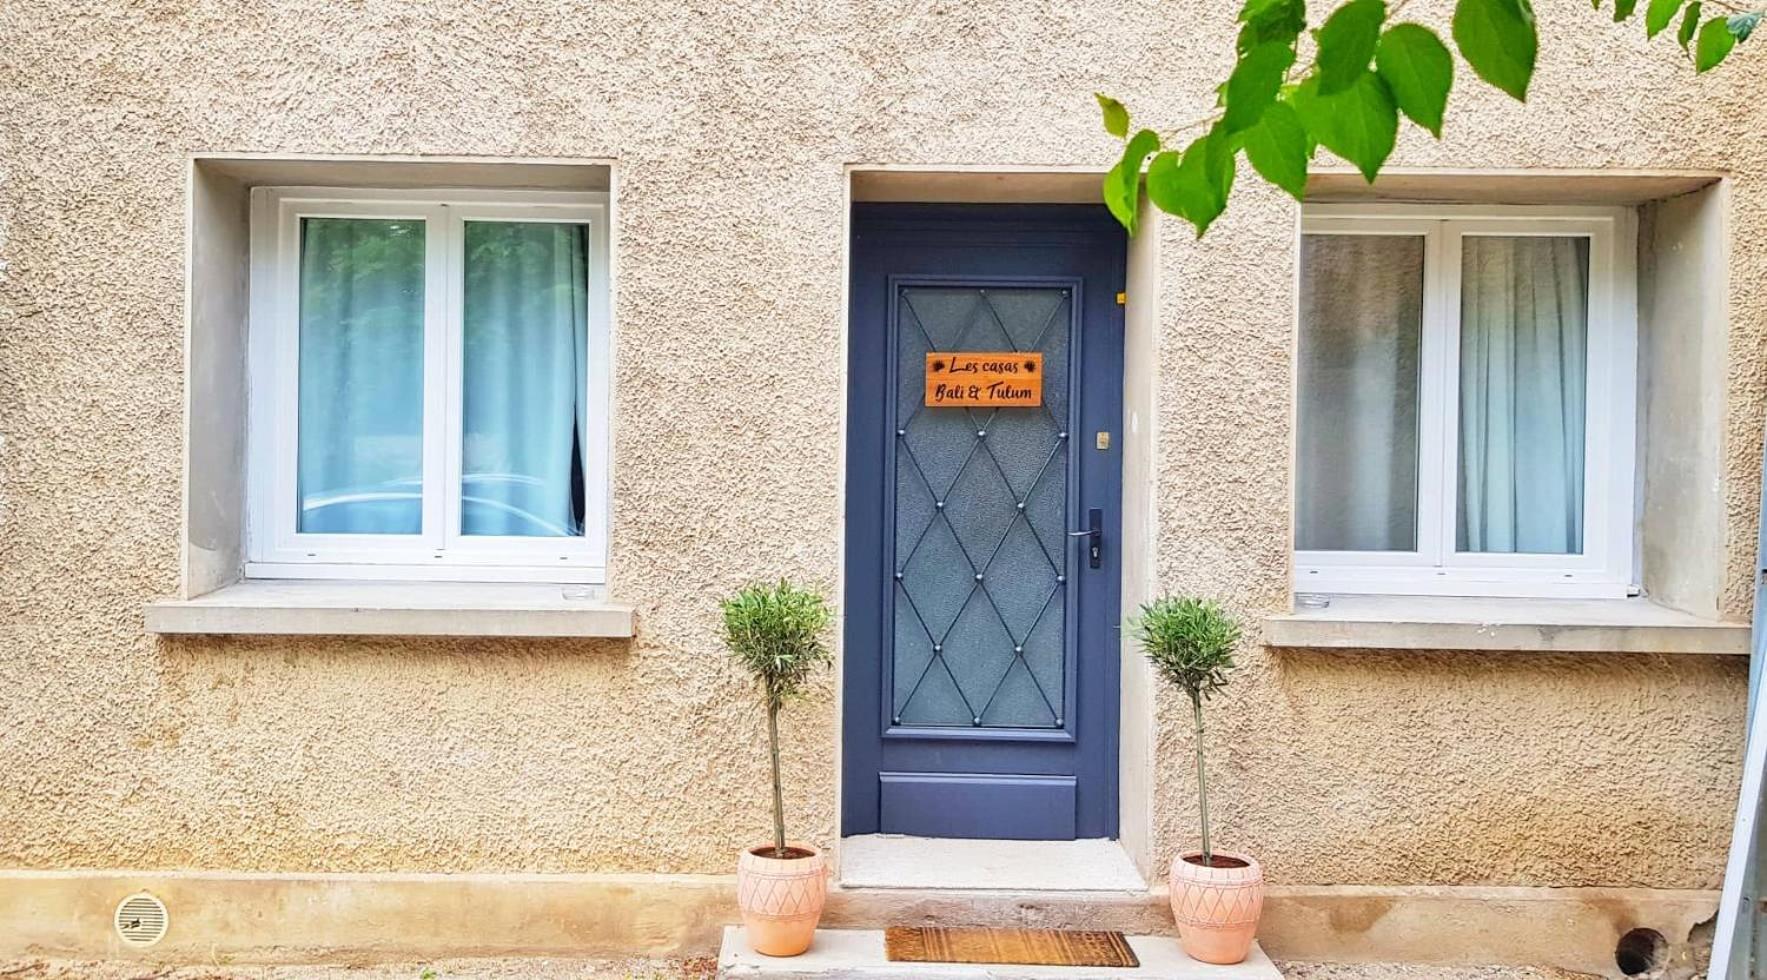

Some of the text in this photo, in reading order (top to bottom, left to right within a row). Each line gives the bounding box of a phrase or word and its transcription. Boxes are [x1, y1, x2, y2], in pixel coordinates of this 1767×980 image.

[949, 356, 1018, 374] Les casas
[935, 381, 1032, 402] Bali & Tulum
